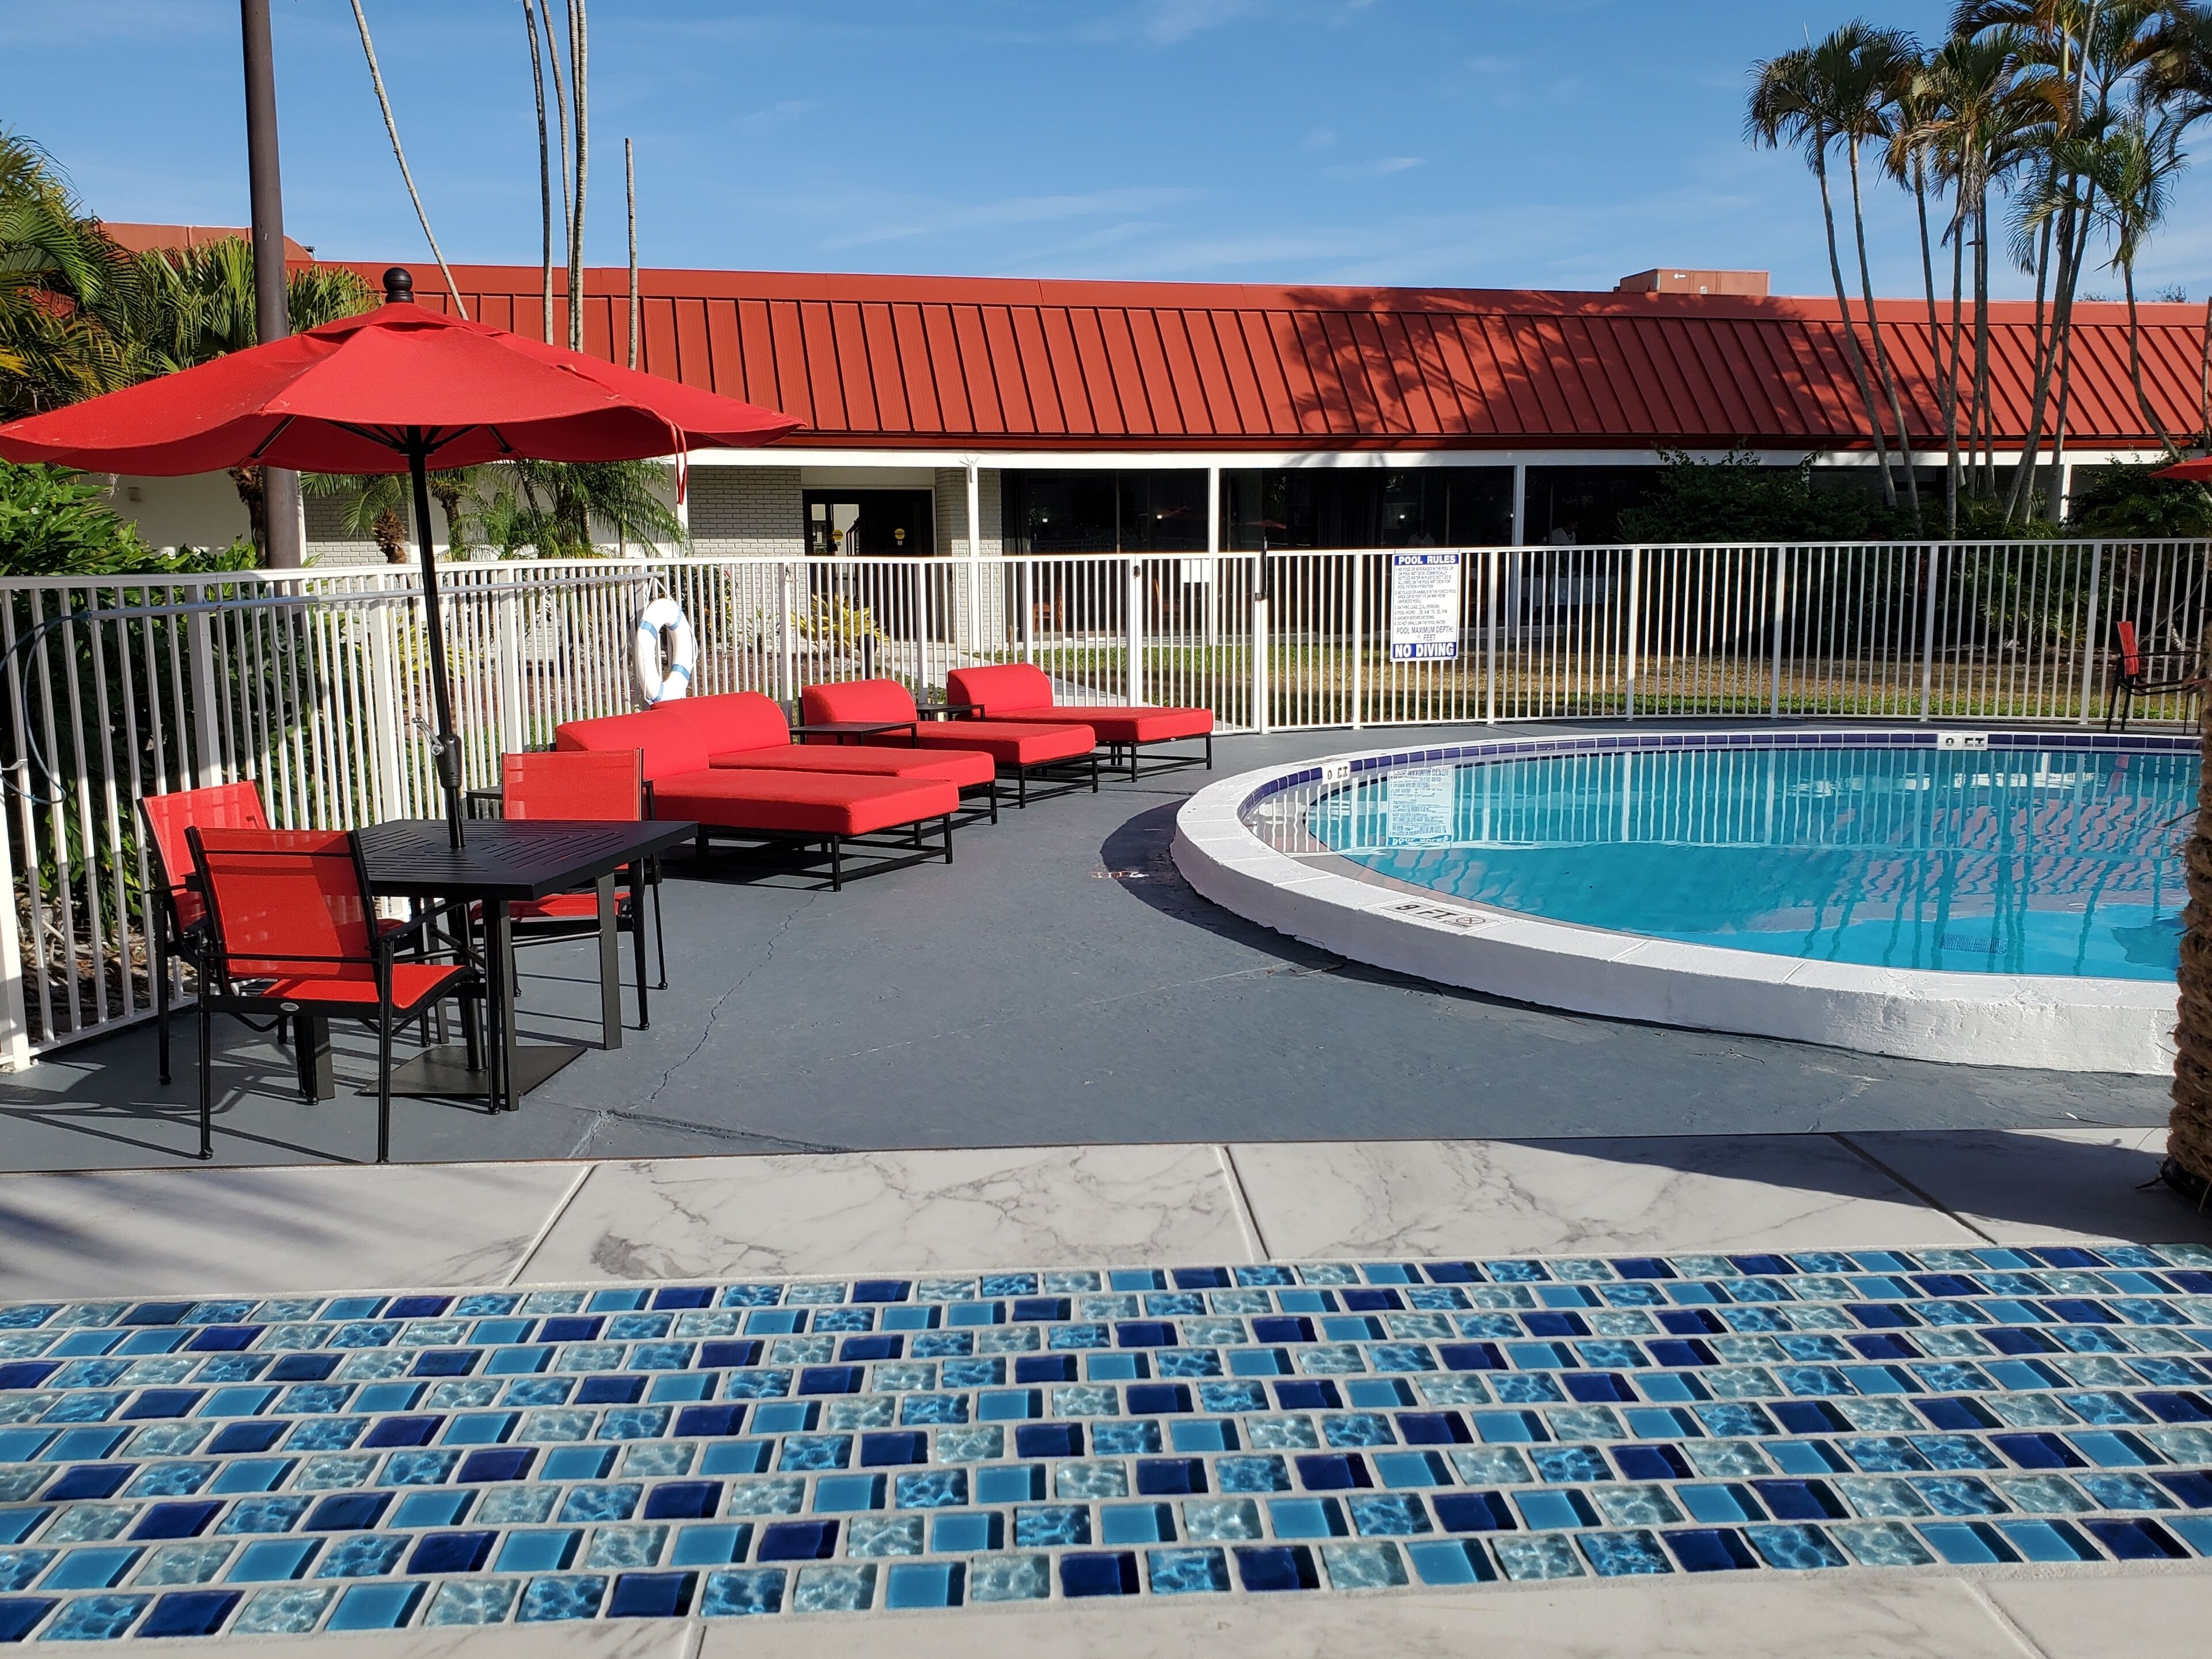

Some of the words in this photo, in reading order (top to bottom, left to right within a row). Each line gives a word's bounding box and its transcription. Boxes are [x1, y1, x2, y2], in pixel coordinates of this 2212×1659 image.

[1399, 556, 1423, 565] POOL
[1427, 555, 1456, 564] RULES
[1395, 644, 1411, 658] NO
[1416, 642, 1454, 657] DIVING
